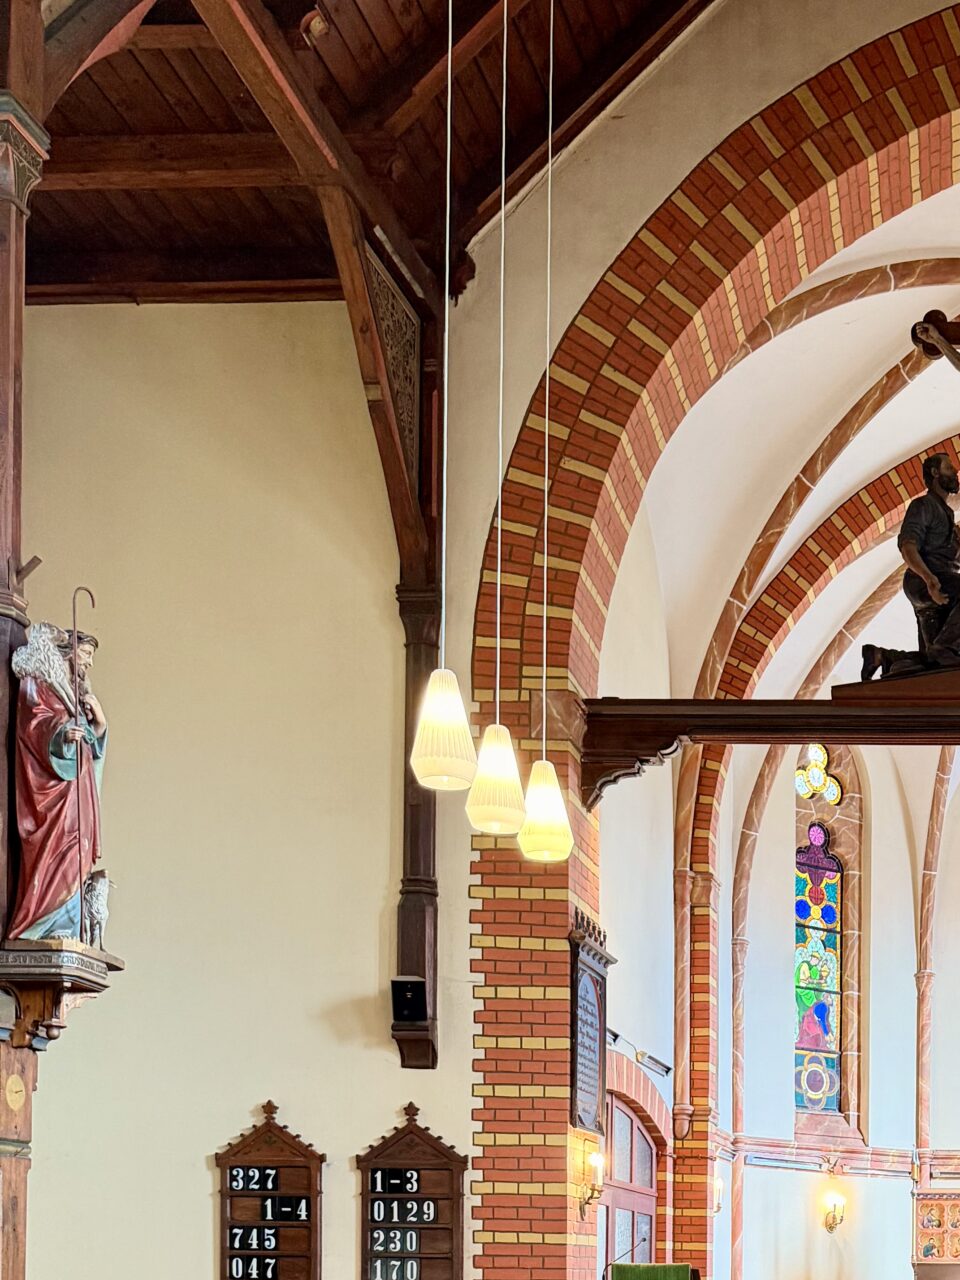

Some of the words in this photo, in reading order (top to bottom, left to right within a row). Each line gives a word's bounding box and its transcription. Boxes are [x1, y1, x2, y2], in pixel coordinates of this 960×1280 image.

[231, 1168, 276, 1190] 327
[374, 1201, 435, 1221] 0129
[232, 1229, 276, 1249] 745
[374, 1230, 417, 1251] 230
[232, 1258, 276, 1278] 047
[374, 1260, 417, 1280] 170
